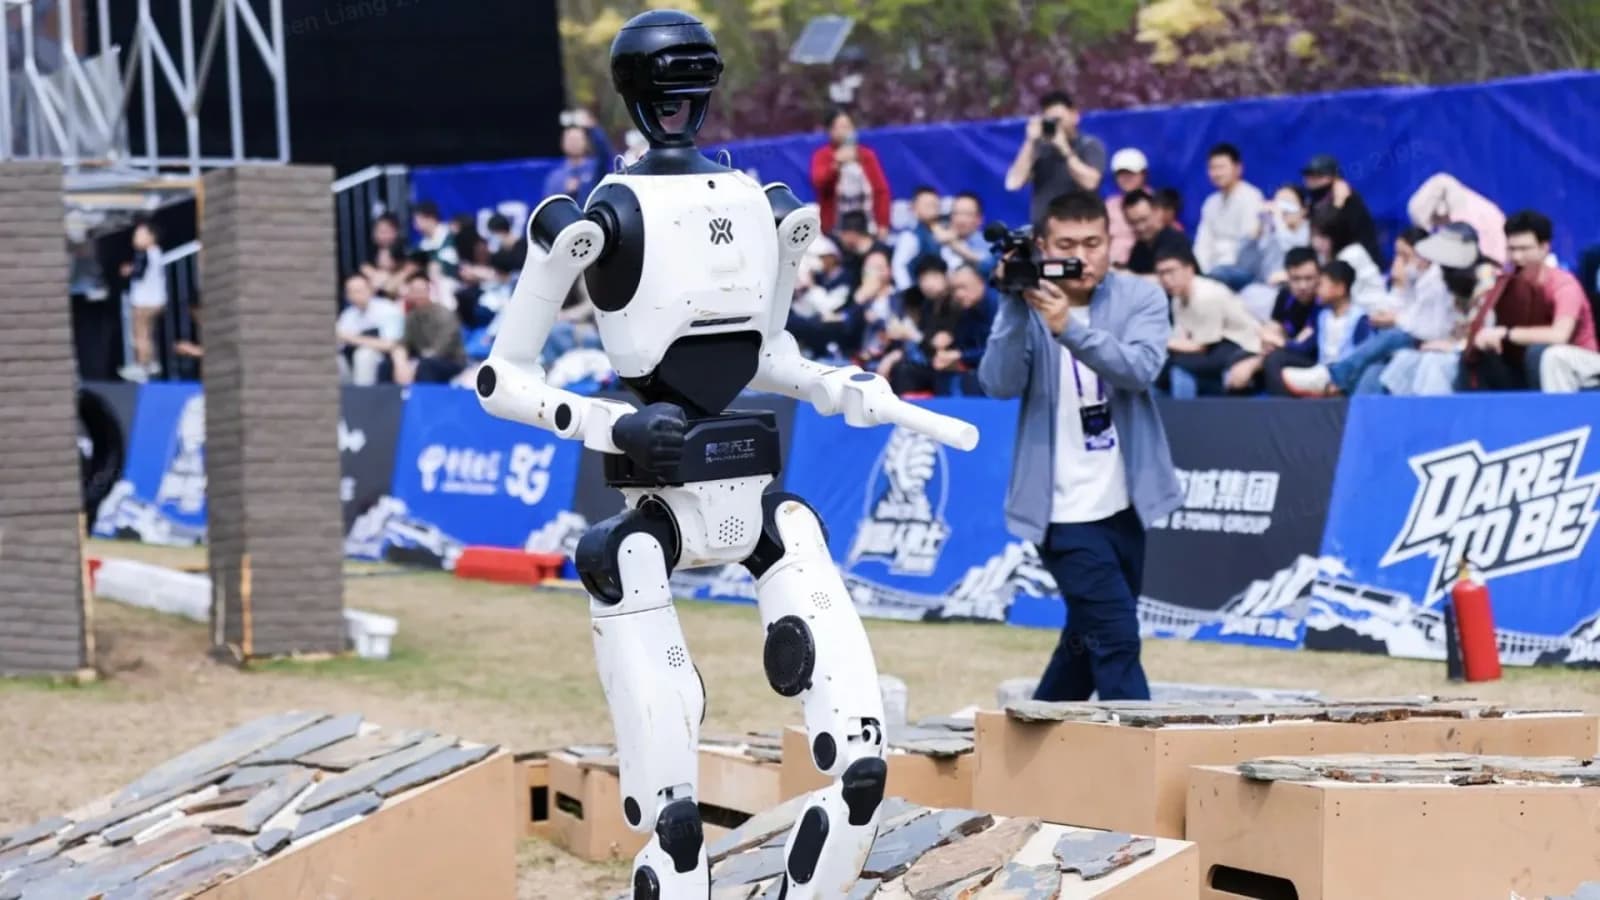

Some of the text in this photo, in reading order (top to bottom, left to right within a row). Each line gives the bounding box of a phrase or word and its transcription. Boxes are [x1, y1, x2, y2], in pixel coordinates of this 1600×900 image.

[505, 442, 556, 506] 5G
[1404, 442, 1576, 546] DARE
[1443, 485, 1593, 581] TO BE
